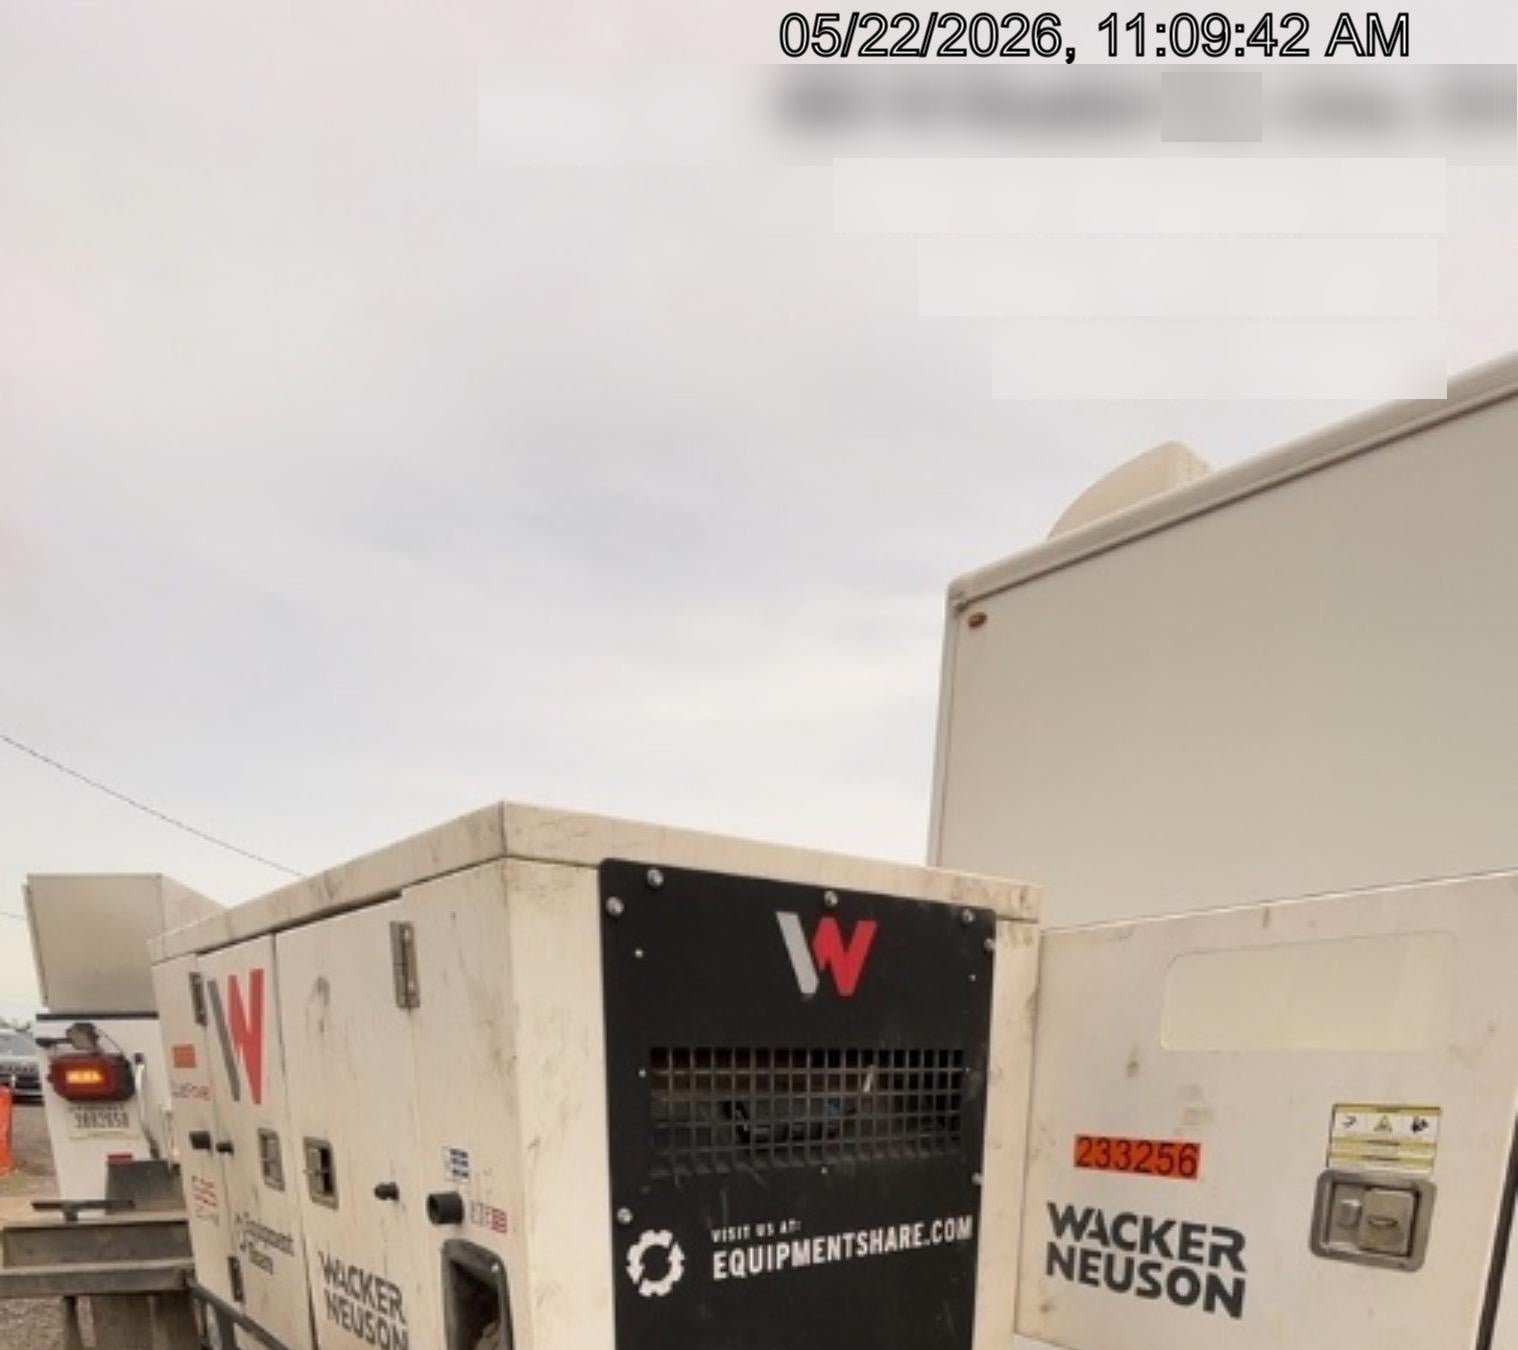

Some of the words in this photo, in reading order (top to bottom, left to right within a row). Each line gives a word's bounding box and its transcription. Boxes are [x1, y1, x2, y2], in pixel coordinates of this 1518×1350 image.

[1075, 1136, 1199, 1178] 233256
[711, 1223, 751, 1243] VISIT
[755, 1220, 774, 1238] US
[712, 1214, 973, 1281] EQUIPMENTSHARE.COM
[1047, 1201, 1247, 1273] WACKER
[318, 1250, 407, 1325] WACKER
[1046, 1241, 1246, 1319] NEUSON
